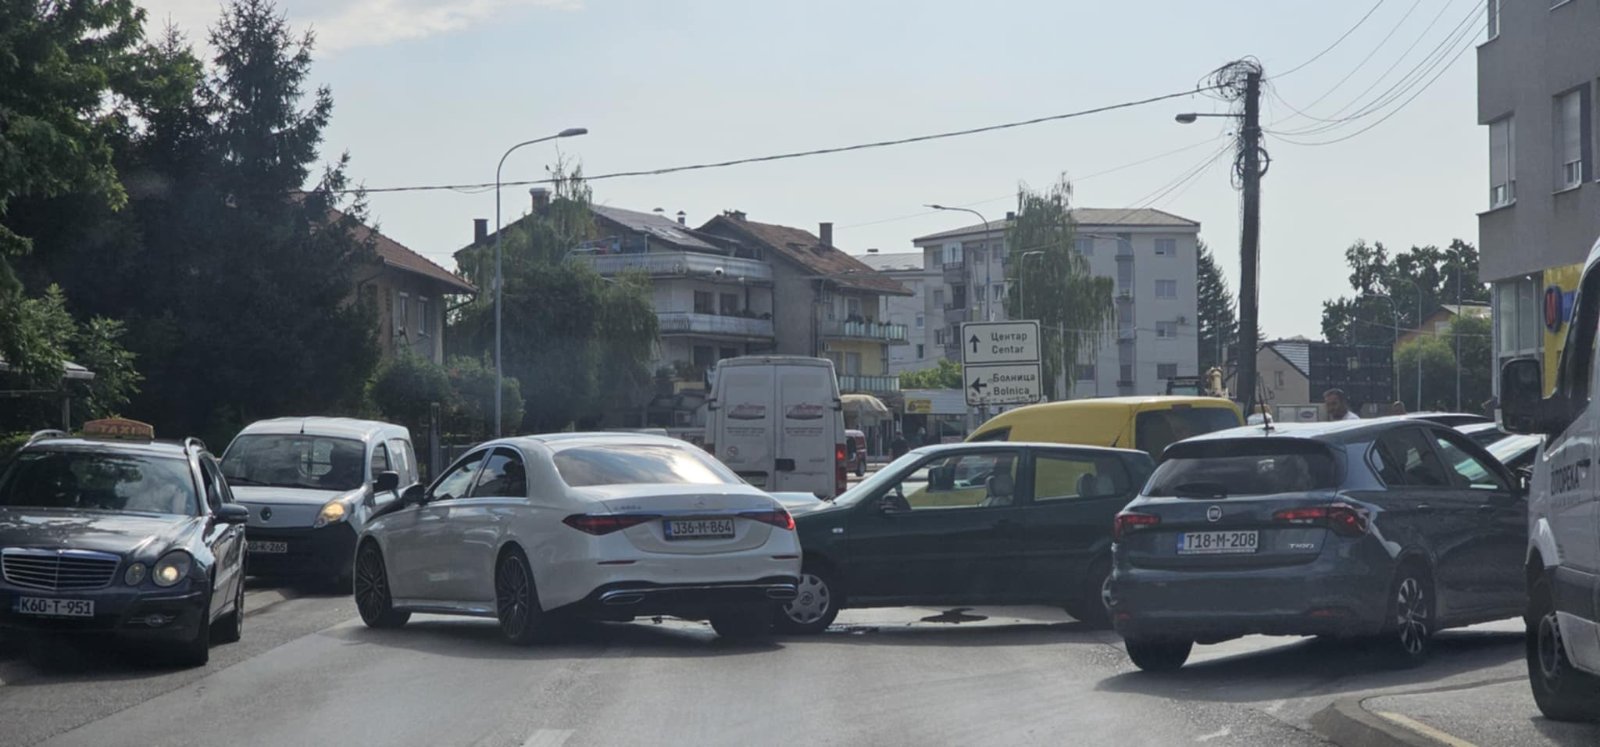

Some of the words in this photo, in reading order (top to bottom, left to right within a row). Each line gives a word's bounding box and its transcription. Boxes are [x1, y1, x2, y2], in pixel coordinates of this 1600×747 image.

[991, 332, 1028, 342] Центар
[991, 345, 1025, 354] Centar
[992, 373, 1036, 383] Болница
[993, 387, 1030, 396] Bolnica
[673, 521, 732, 534] J36-M-864
[1186, 532, 1257, 549] T18-M-208
[248, 542, 286, 552] 60-K-265
[21, 598, 92, 615] K60-T-951
